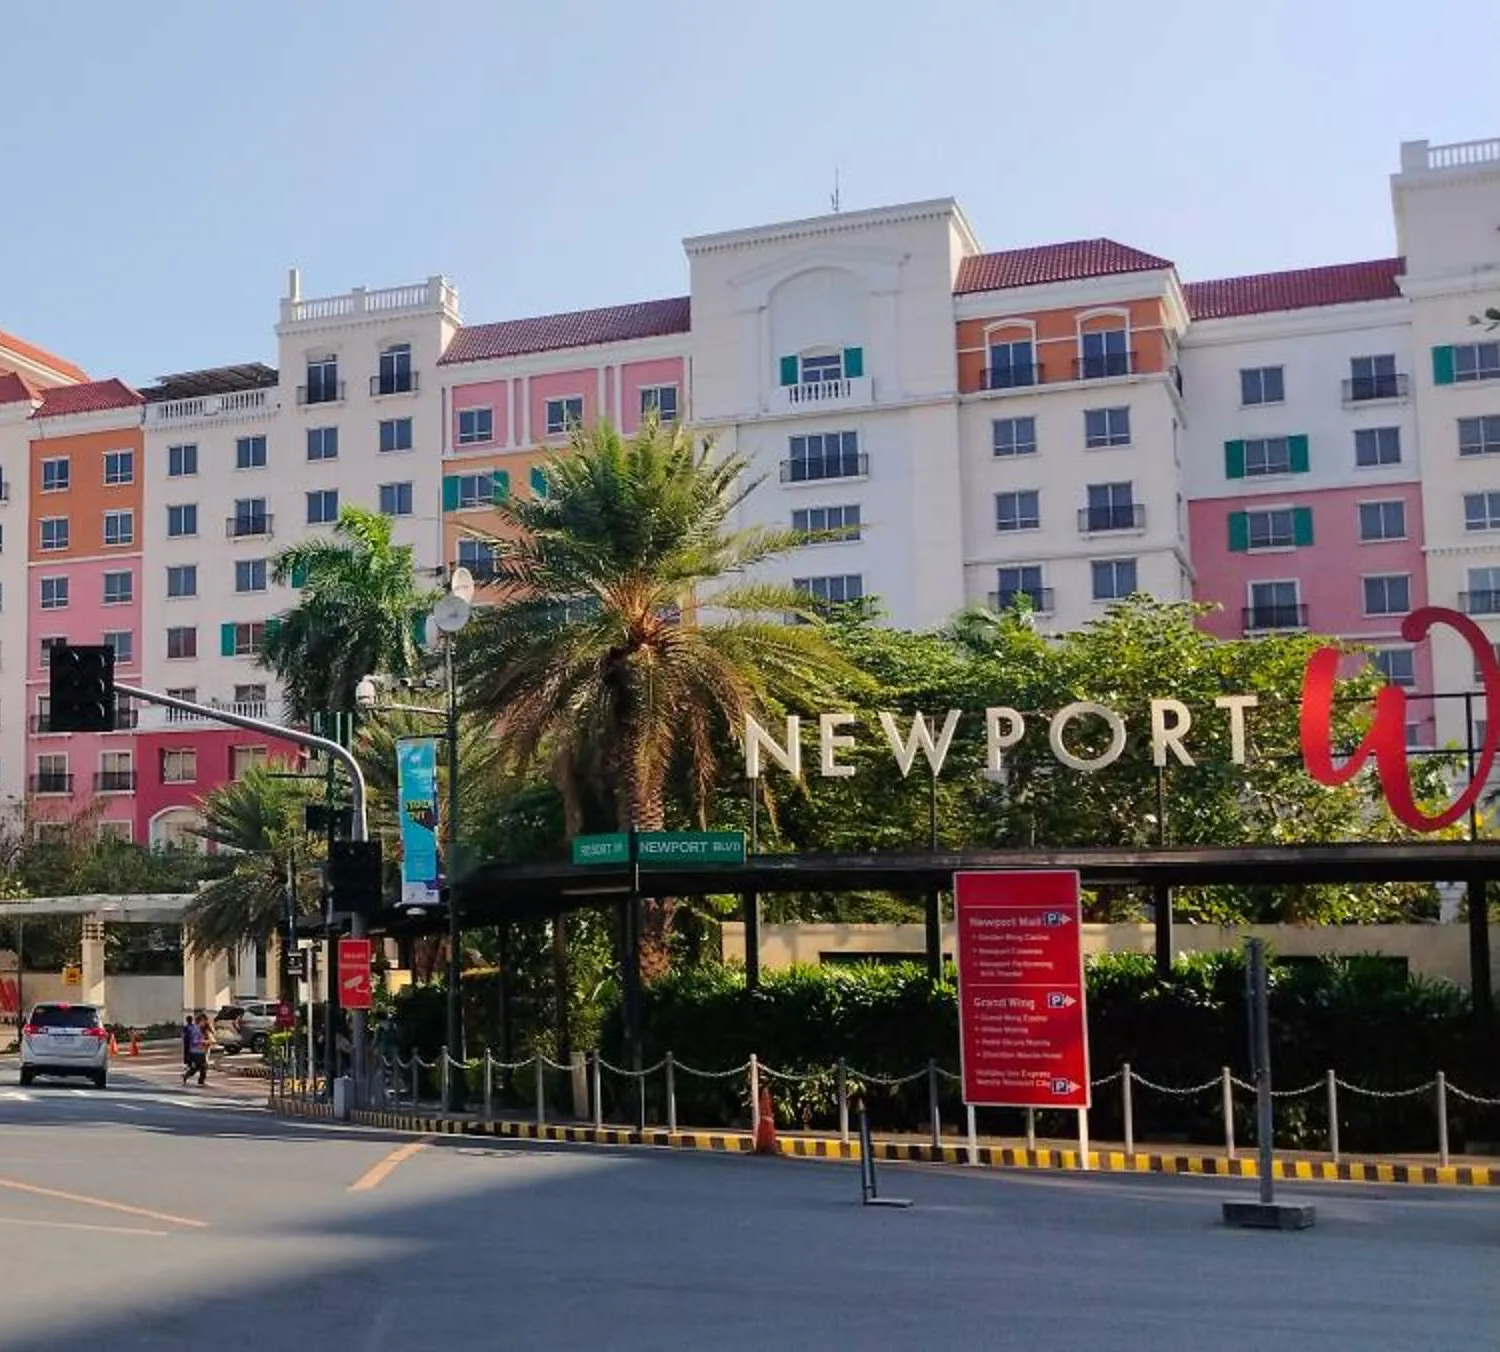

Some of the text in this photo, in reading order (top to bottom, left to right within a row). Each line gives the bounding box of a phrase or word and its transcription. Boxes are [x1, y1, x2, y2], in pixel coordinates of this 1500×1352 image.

[745, 694, 1259, 778] NEWPORT
[639, 841, 741, 853] NEWPORT BLVD
[968, 917, 1017, 928] Newport
[1019, 917, 1041, 926] Mall
[973, 998, 1006, 1007] Grand
[1008, 998, 1035, 1011] Wing
